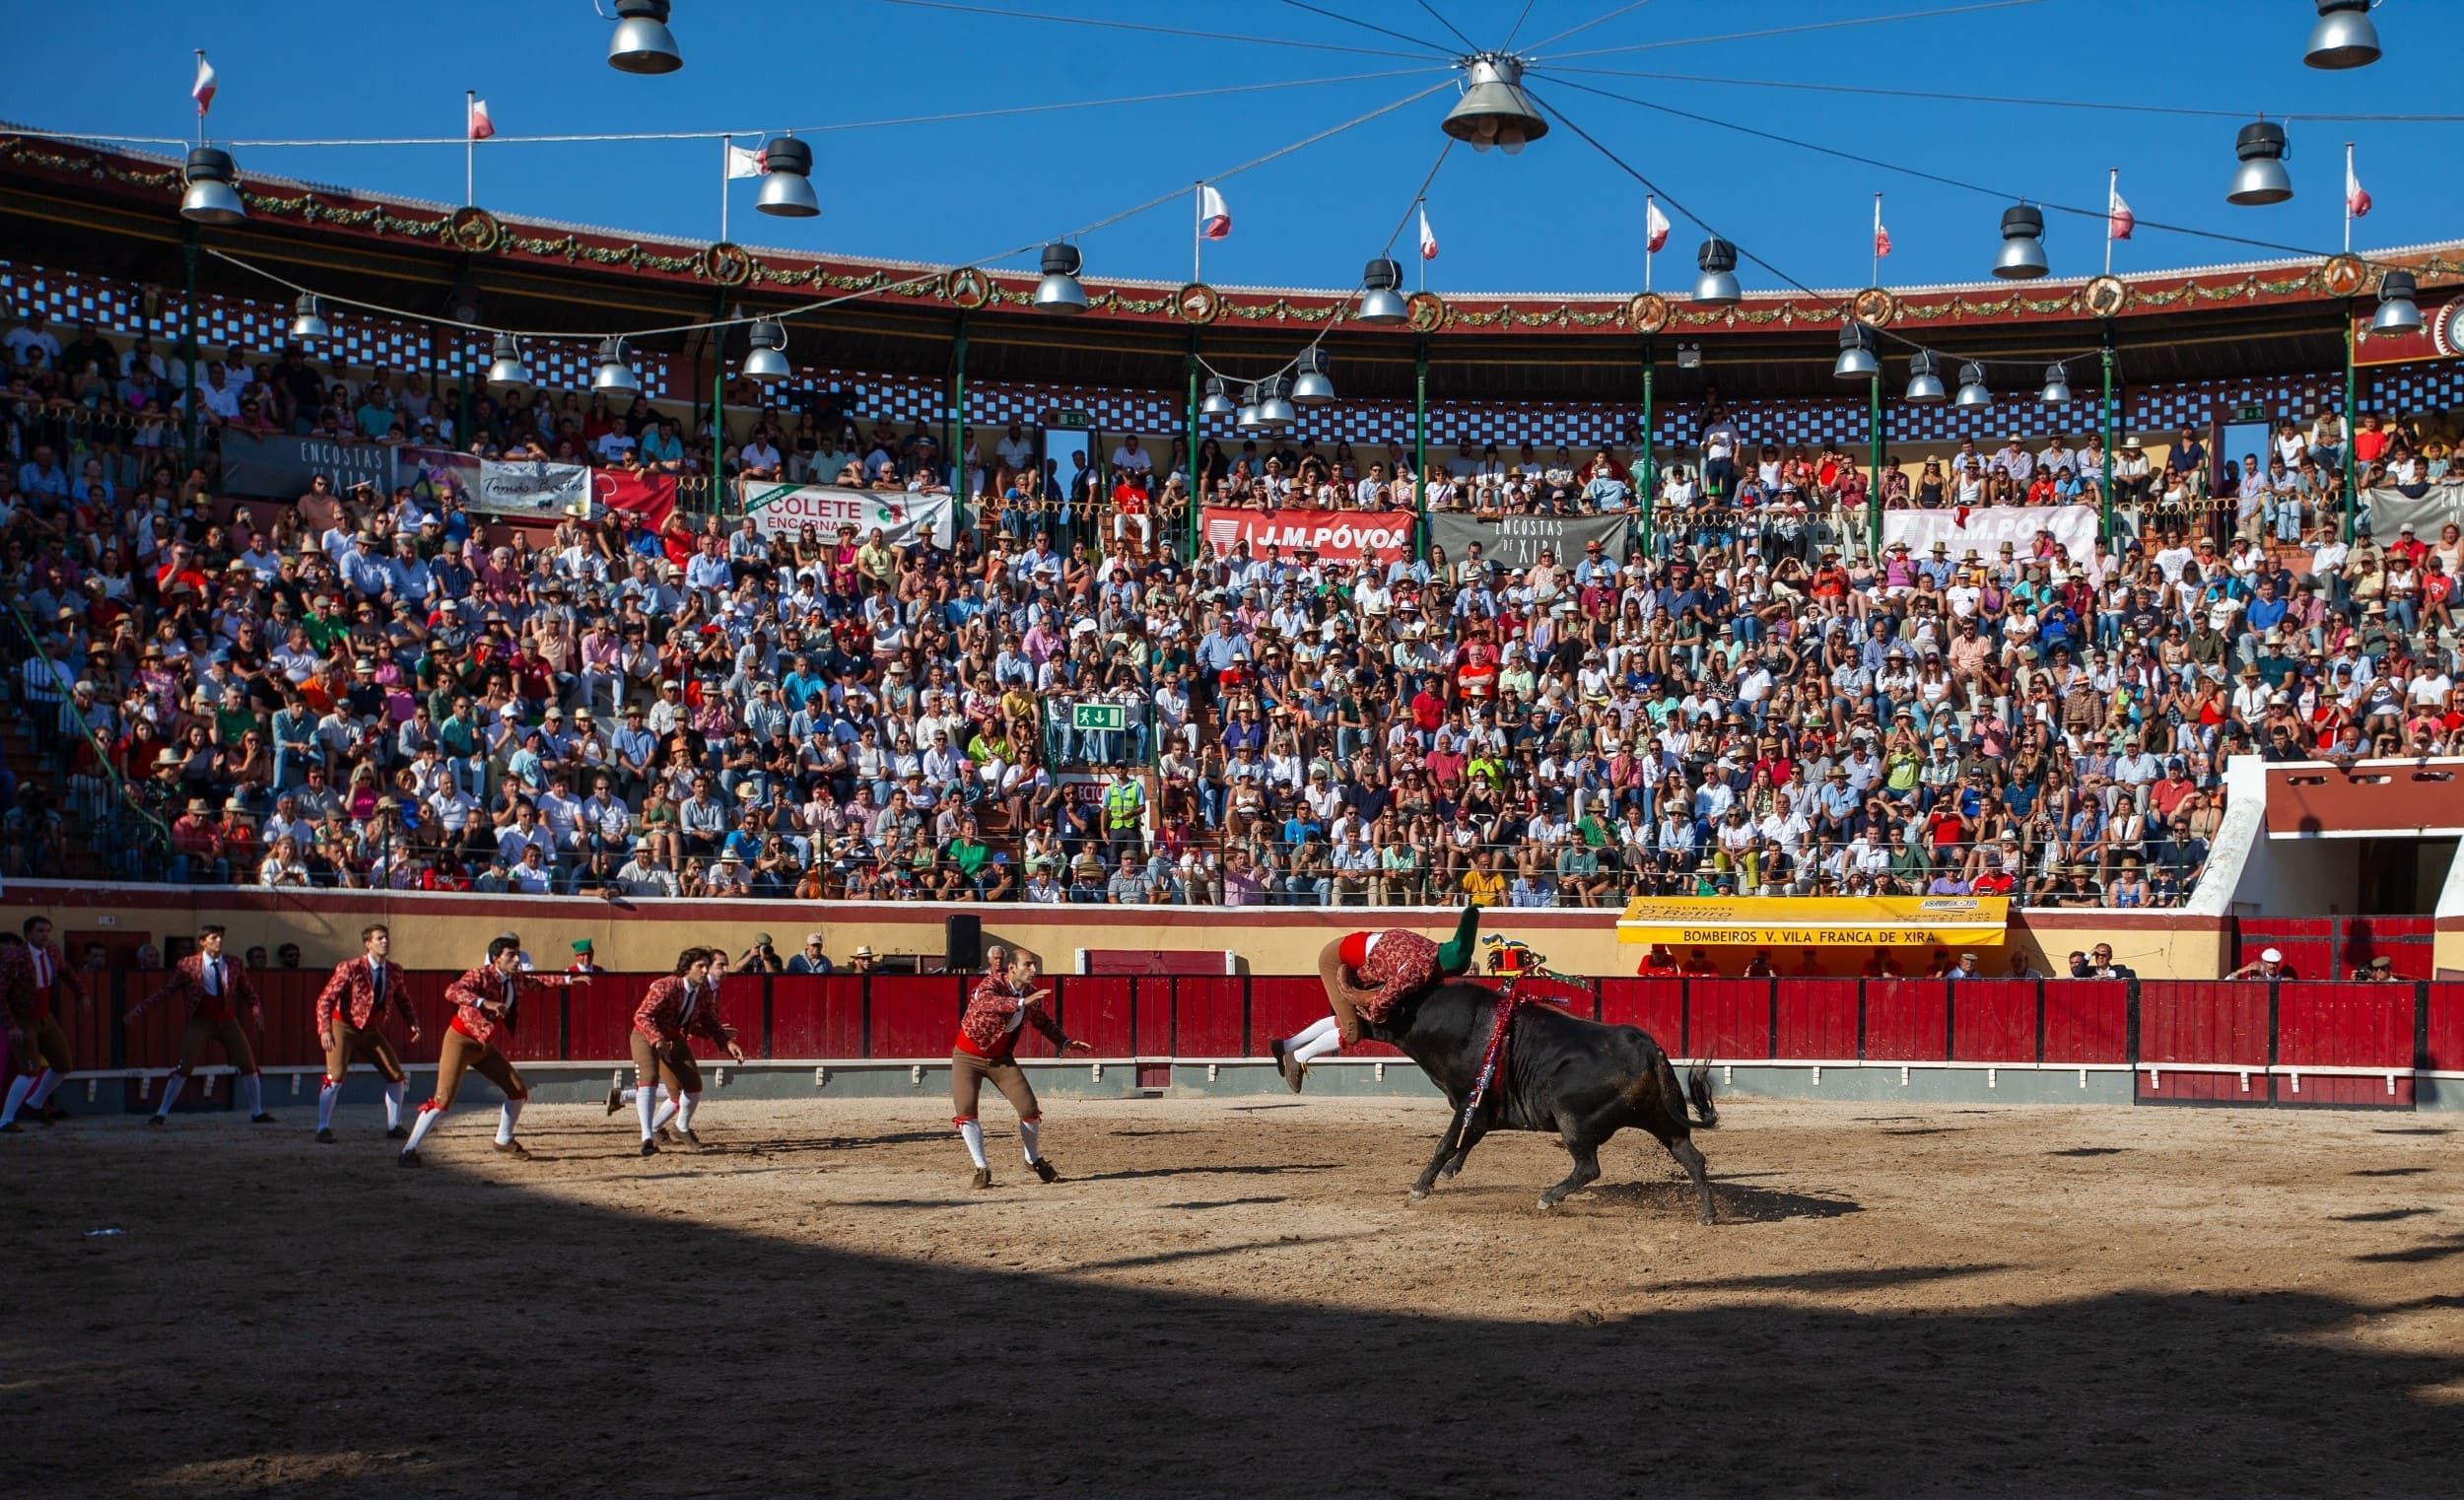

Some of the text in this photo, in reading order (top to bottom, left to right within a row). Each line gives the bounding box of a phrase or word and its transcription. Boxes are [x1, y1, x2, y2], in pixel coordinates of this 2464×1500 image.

[301, 442, 382, 469] ENCOSTAS
[767, 497, 862, 519] COLETE
[767, 516, 863, 533] ENCARNAO
[1495, 519, 1563, 537] ENCOSTAS
[1257, 523, 1406, 549] J.M.PÓVOA
[1503, 539, 1513, 552] DE
[1078, 785, 1105, 801] ECTO
[1683, 930, 1936, 943] BOMBEIROS V. VILA FRANCA DE XIRA
